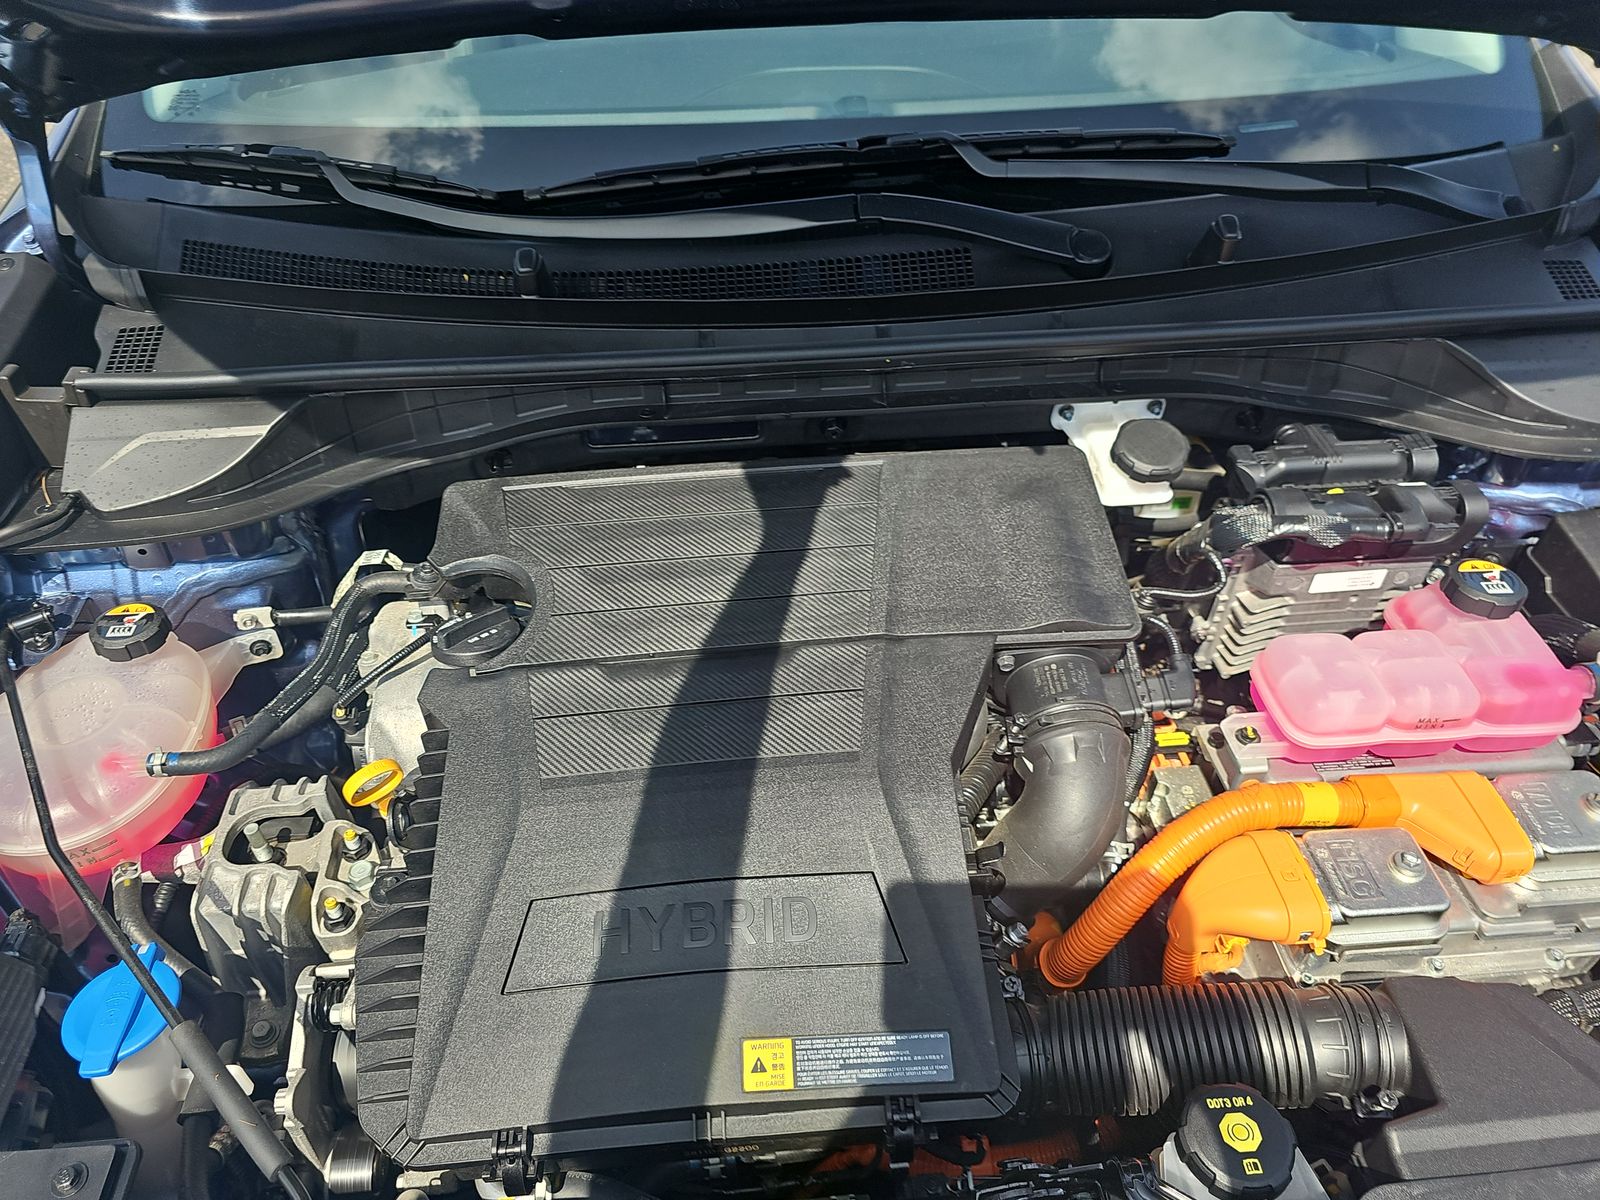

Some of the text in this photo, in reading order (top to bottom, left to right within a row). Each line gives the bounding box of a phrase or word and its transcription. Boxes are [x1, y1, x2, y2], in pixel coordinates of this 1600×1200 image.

[593, 896, 818, 957] HYBRID
[750, 1042, 784, 1050] WARNING
[1205, 1095, 1254, 1109] DOT3 OR 4
